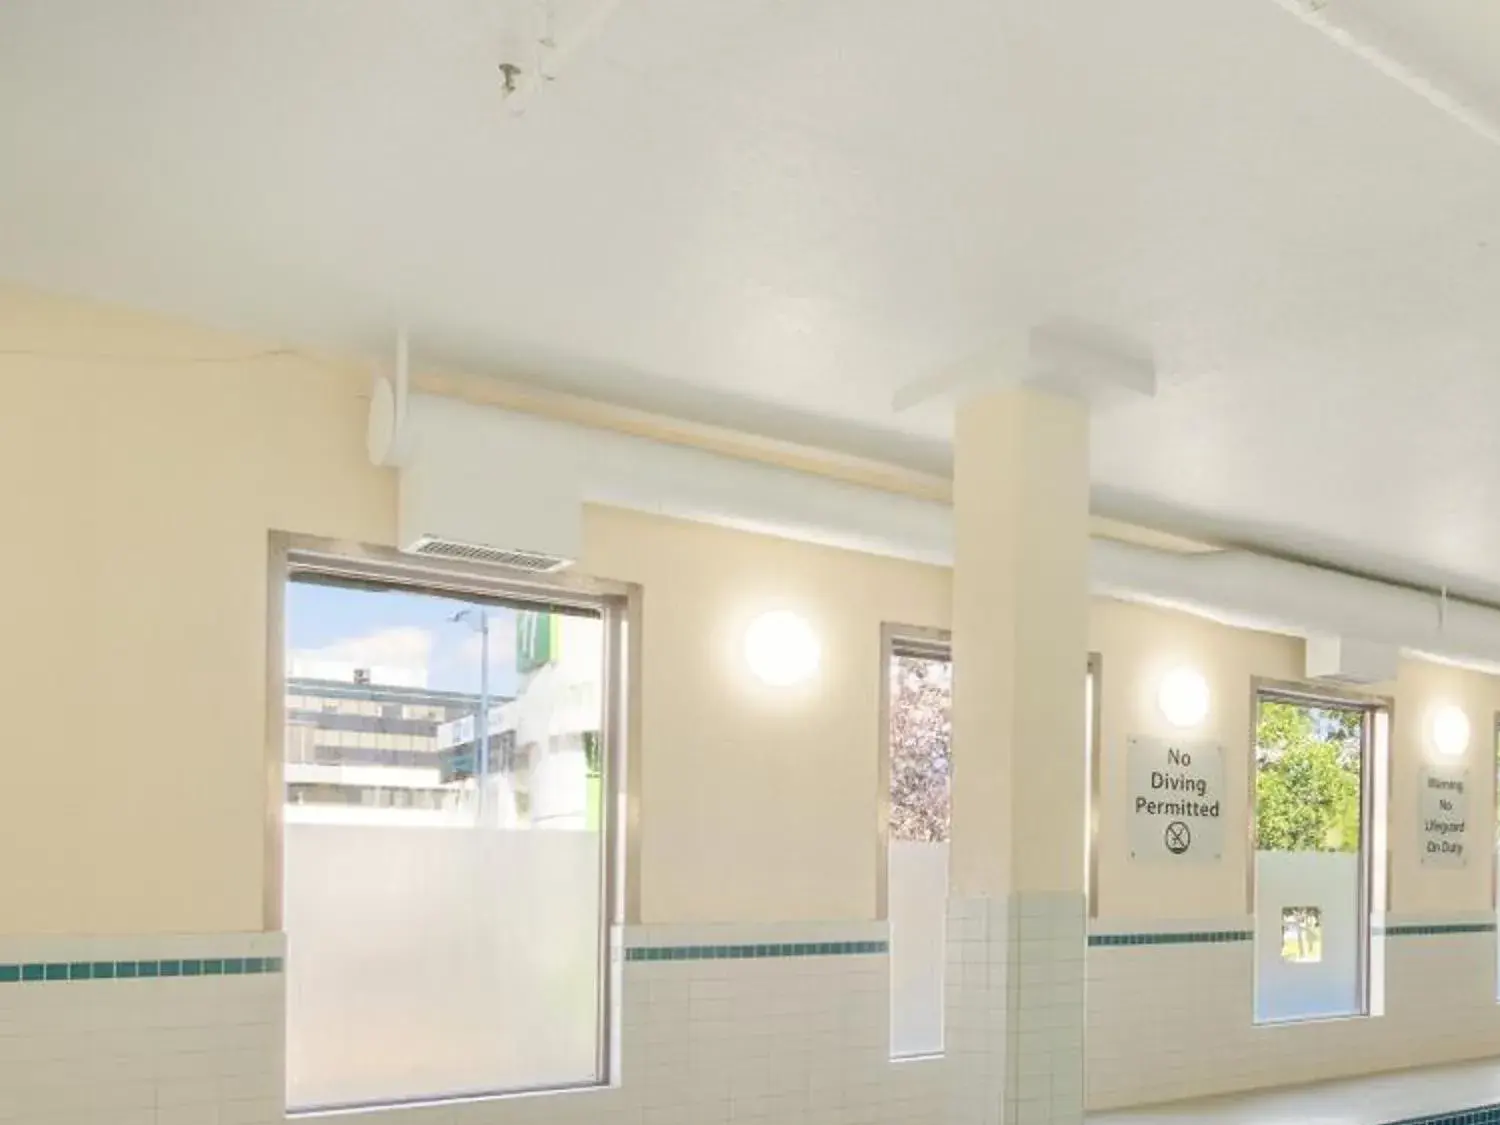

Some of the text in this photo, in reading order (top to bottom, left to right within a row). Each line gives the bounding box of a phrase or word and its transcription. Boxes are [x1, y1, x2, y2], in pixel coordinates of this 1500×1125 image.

[1168, 748, 1191, 766] No
[1151, 771, 1207, 796] Diving
[1135, 796, 1220, 817] Permitted
[1439, 799, 1453, 811] No
